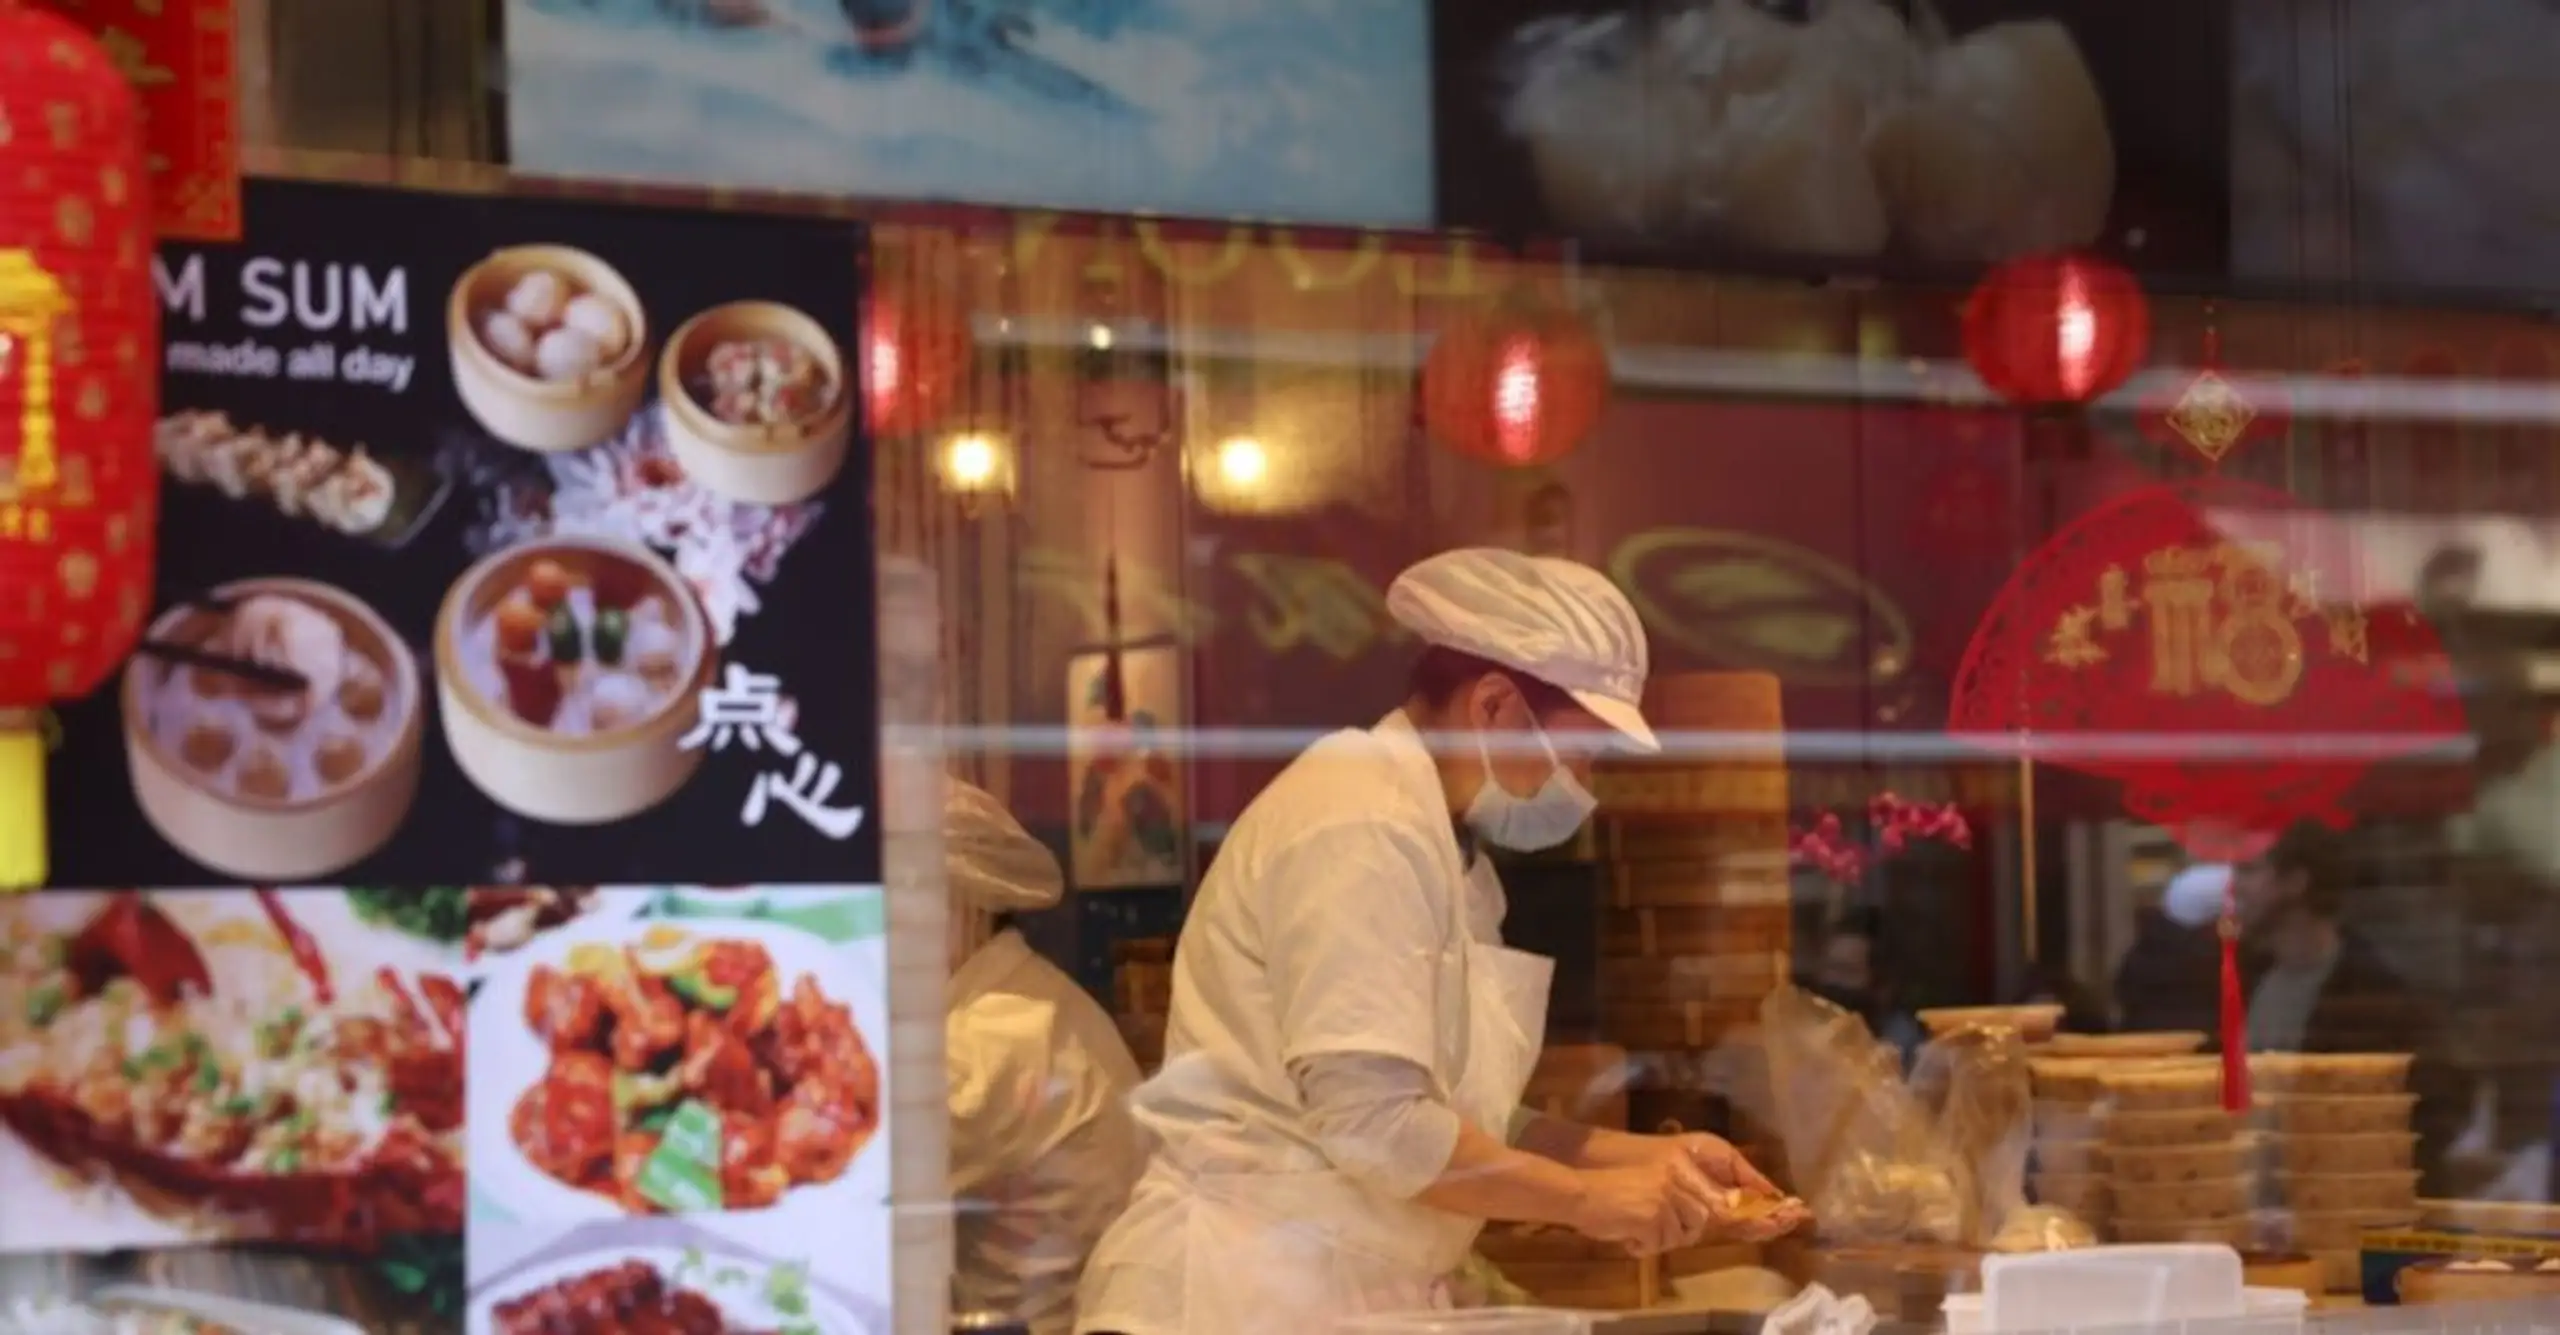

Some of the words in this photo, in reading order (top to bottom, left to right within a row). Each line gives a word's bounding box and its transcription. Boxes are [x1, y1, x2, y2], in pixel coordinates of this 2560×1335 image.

[240, 256, 408, 334] SUM
[166, 339, 280, 378] made
[287, 341, 335, 379] all
[341, 344, 414, 393] day
[677, 660, 864, 840] 点心
